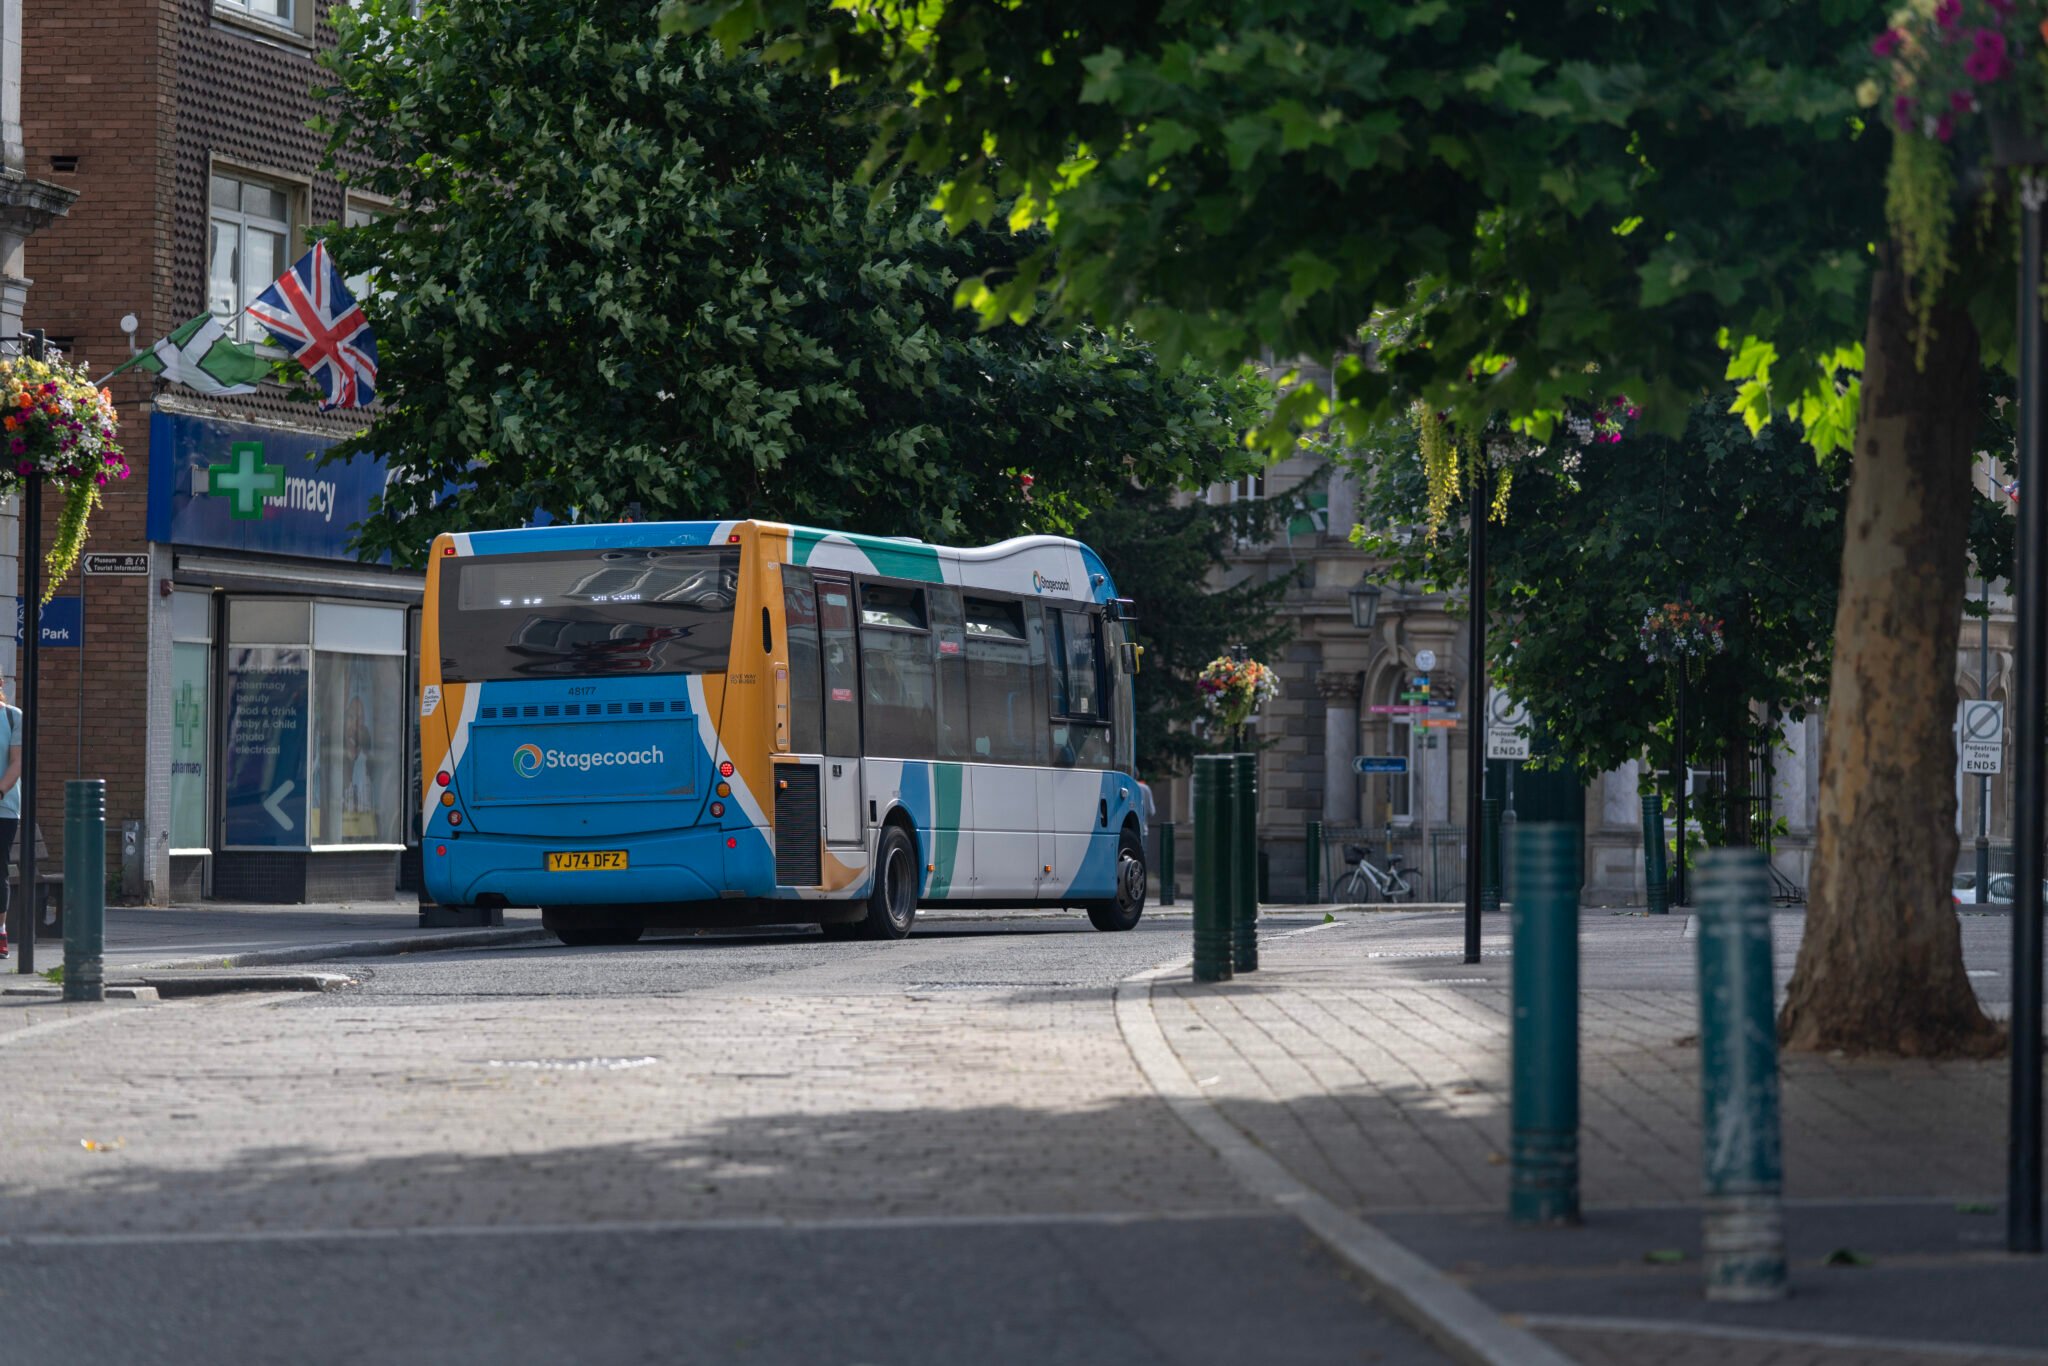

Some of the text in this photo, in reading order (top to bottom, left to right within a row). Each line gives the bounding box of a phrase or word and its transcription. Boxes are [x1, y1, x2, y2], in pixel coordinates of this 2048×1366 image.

[94, 556, 117, 564] Museum
[1040, 575, 1070, 592] Stagecoach
[42, 628, 69, 639] Park
[236, 663, 300, 675] welcome
[236, 680, 286, 692] pharmacy
[568, 687, 597, 696] 48177
[236, 694, 270, 704] beauty
[236, 706, 297, 716] food & drink
[236, 719, 297, 730] baby & child
[236, 732, 265, 743] photo
[235, 744, 281, 754] electrical
[1493, 746, 1524, 755] ENDS
[546, 745, 664, 771] Stagecoach
[171, 760, 202, 777] pharmacy
[1967, 761, 1997, 770] ENDS
[555, 853, 621, 868] YJ74 DFZ
